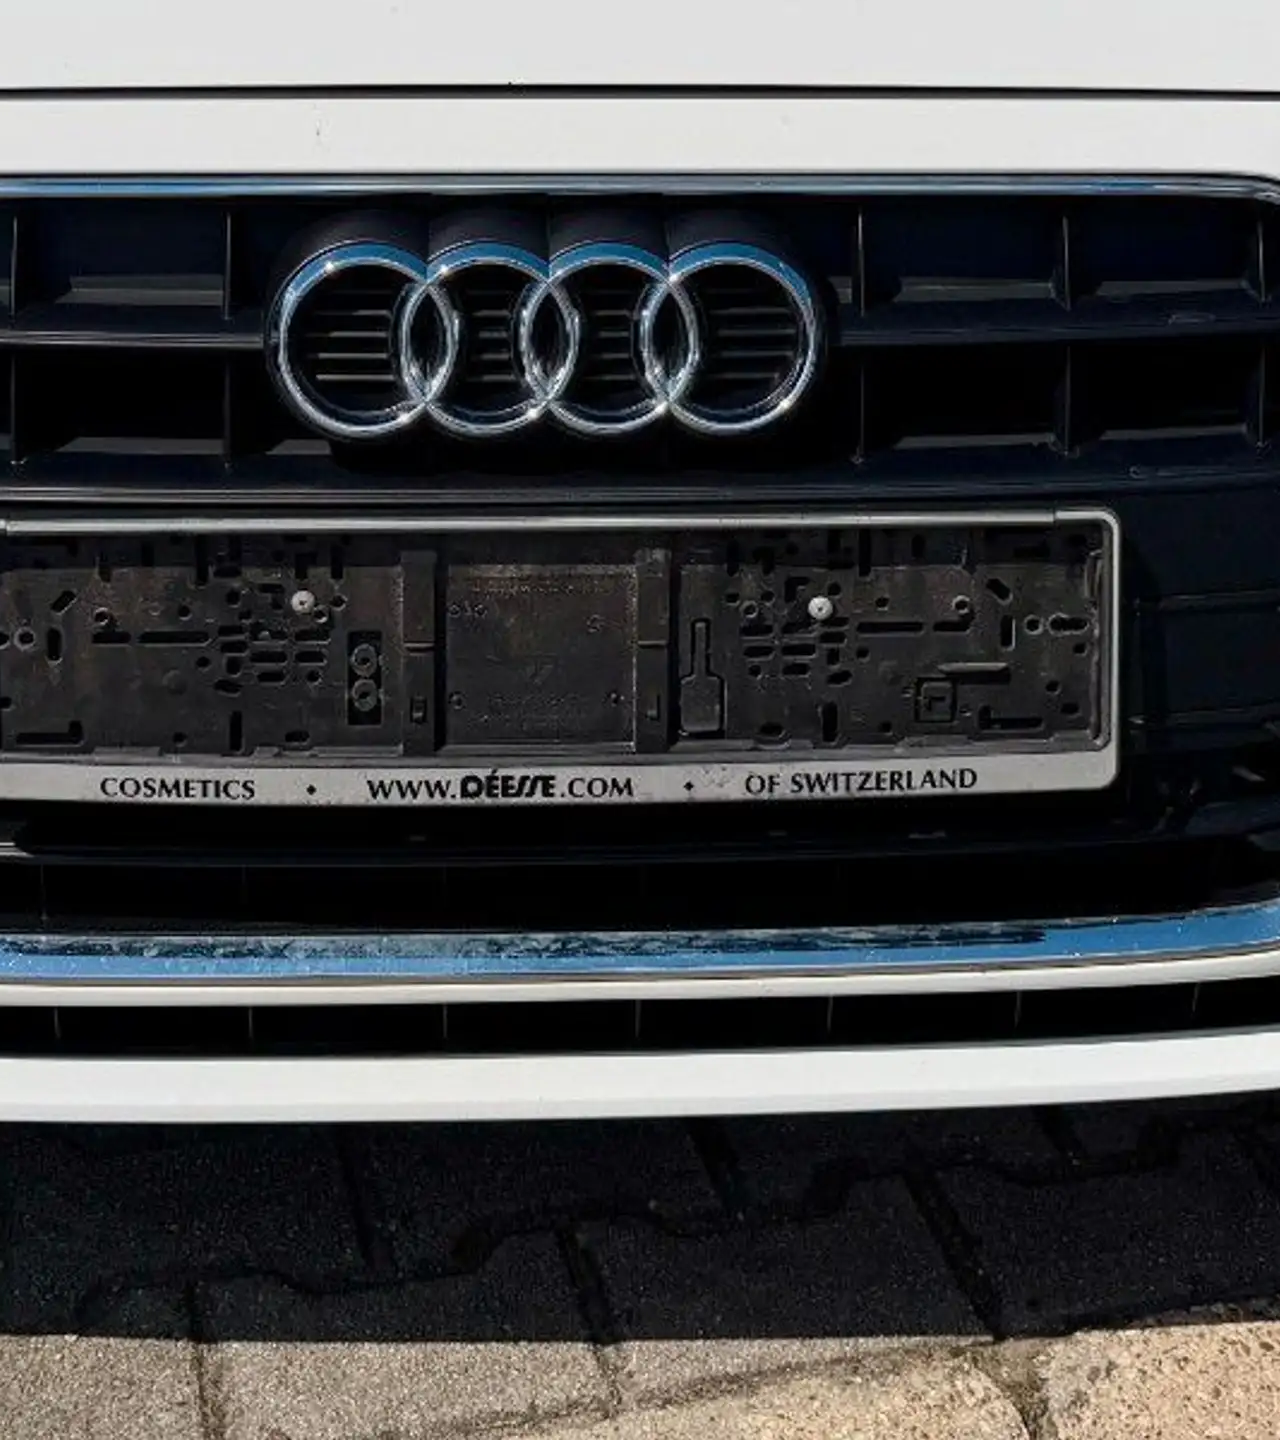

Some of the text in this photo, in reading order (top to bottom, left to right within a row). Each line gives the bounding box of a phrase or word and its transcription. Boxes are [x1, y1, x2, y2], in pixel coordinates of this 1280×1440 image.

[99, 777, 256, 801] COSMETICS
[745, 774, 780, 795] OF
[790, 767, 978, 793] SWITZERLAND
